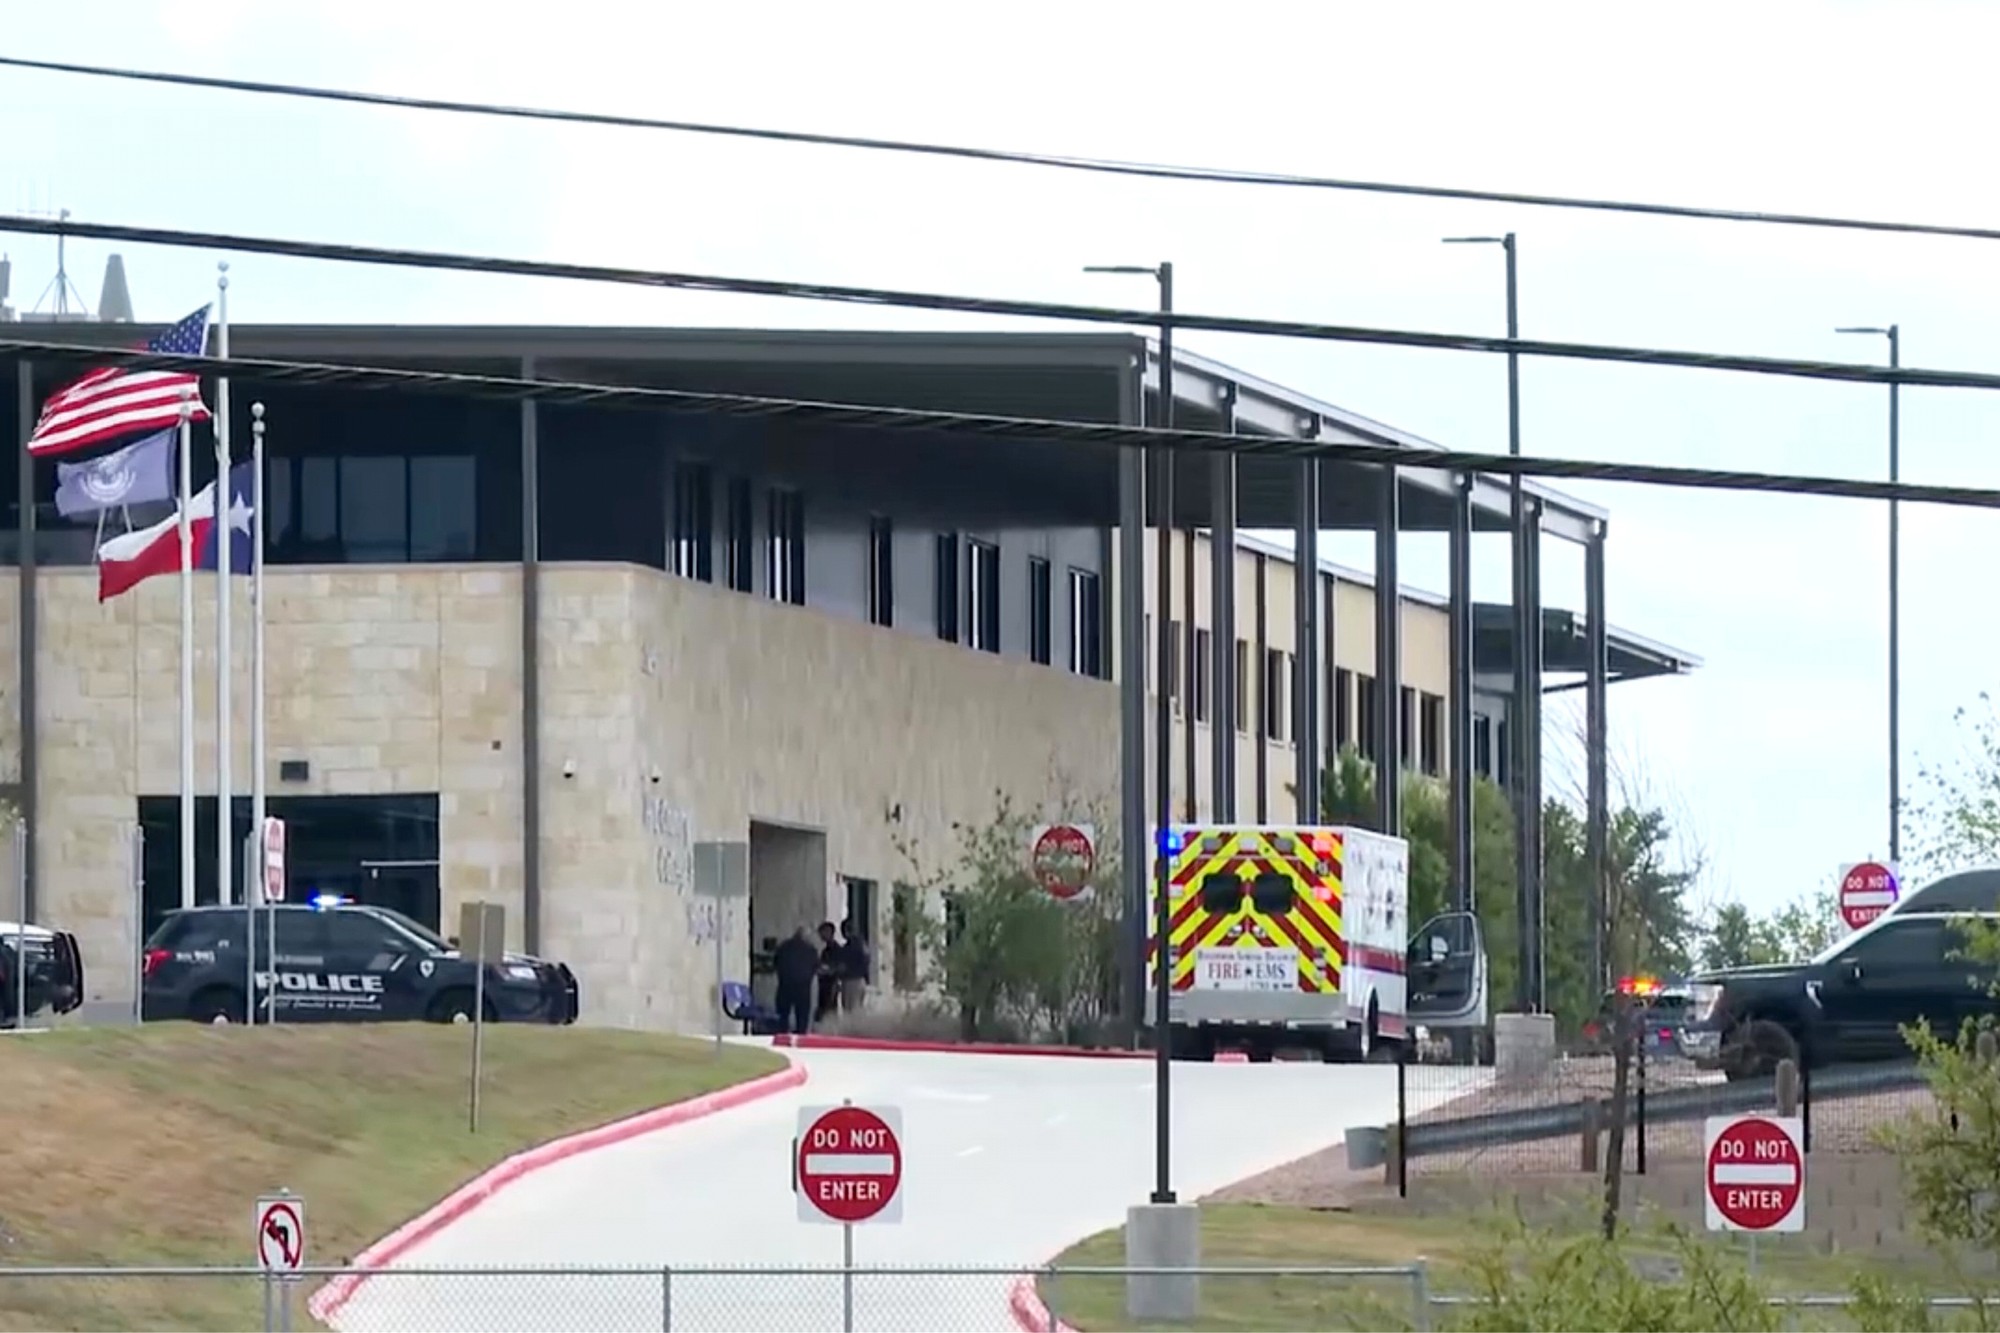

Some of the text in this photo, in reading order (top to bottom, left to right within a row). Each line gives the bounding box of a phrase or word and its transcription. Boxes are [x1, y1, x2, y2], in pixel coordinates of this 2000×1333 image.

[1847, 875, 1891, 890] DO NOT
[255, 971, 385, 993] POLICE
[1208, 963, 1287, 980] FIRE EMS
[813, 1128, 887, 1149] DO NOT
[1720, 1139, 1790, 1160] DO NOT
[820, 1180, 880, 1201] ENTER
[1727, 1189, 1783, 1210] ENTER
